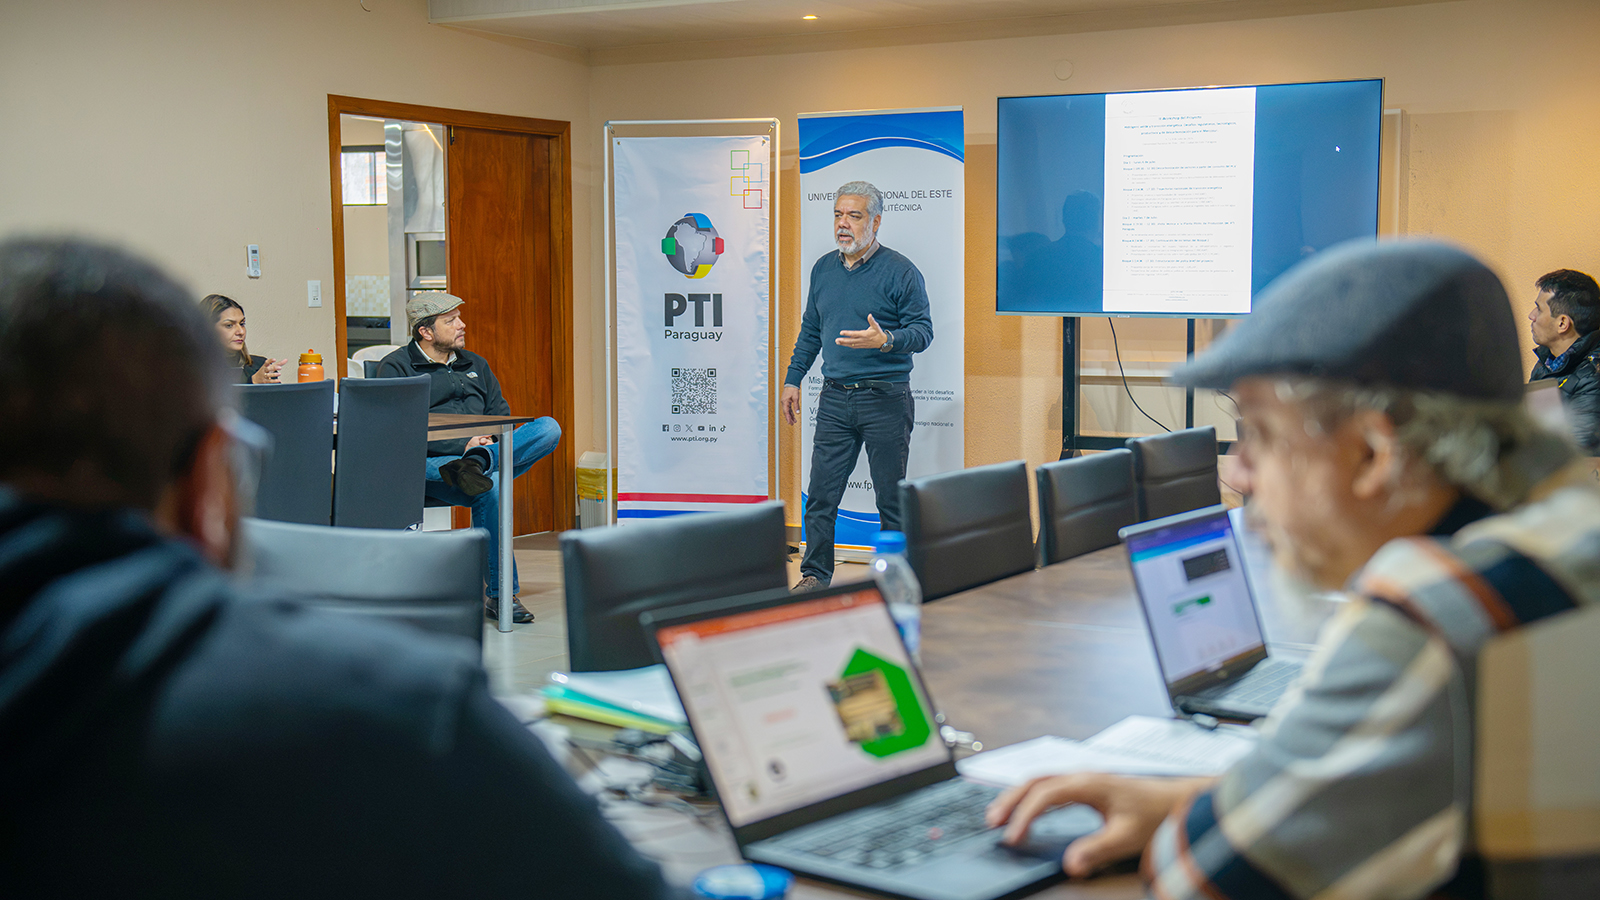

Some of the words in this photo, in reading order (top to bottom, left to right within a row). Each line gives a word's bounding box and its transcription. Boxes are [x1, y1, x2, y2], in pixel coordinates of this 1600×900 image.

[911, 190, 927, 199] DEL
[929, 189, 952, 199] ESTE
[883, 203, 922, 212] LITÉCNICA
[664, 293, 723, 327] PTI
[664, 329, 723, 342] Paraguay
[808, 376, 822, 384] Misi
[670, 435, 718, 443] www.pti.org.py
